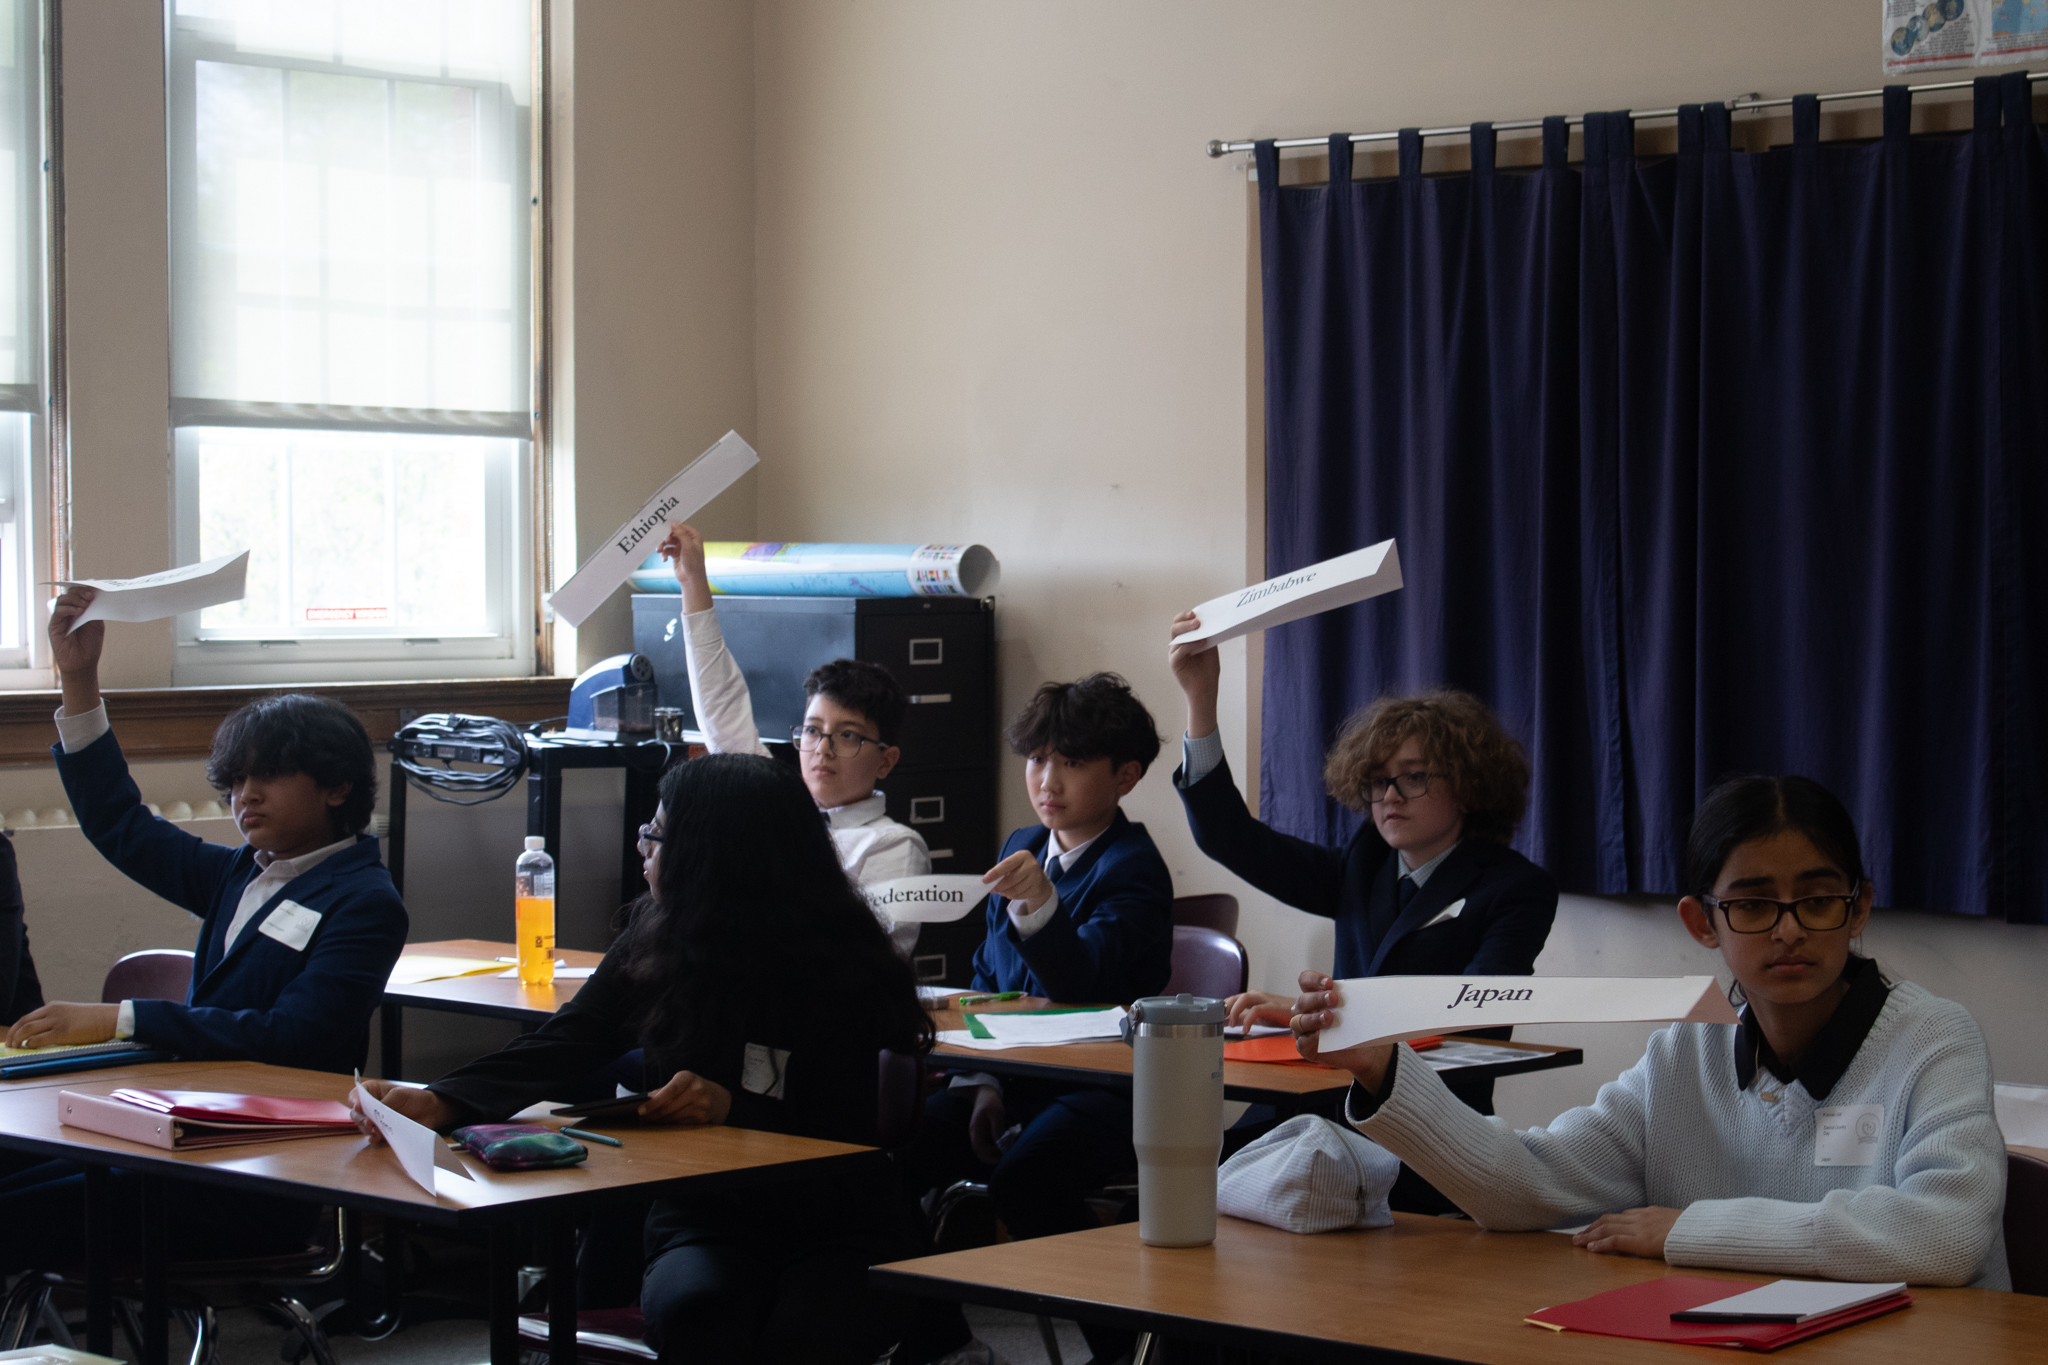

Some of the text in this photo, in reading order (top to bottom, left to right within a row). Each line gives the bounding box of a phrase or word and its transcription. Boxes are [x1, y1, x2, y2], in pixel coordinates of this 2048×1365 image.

[616, 496, 679, 556] Ethiopia
[1236, 572, 1317, 608] Zimbabwe
[868, 884, 964, 907] ederation
[1447, 983, 1533, 1009] Japan
